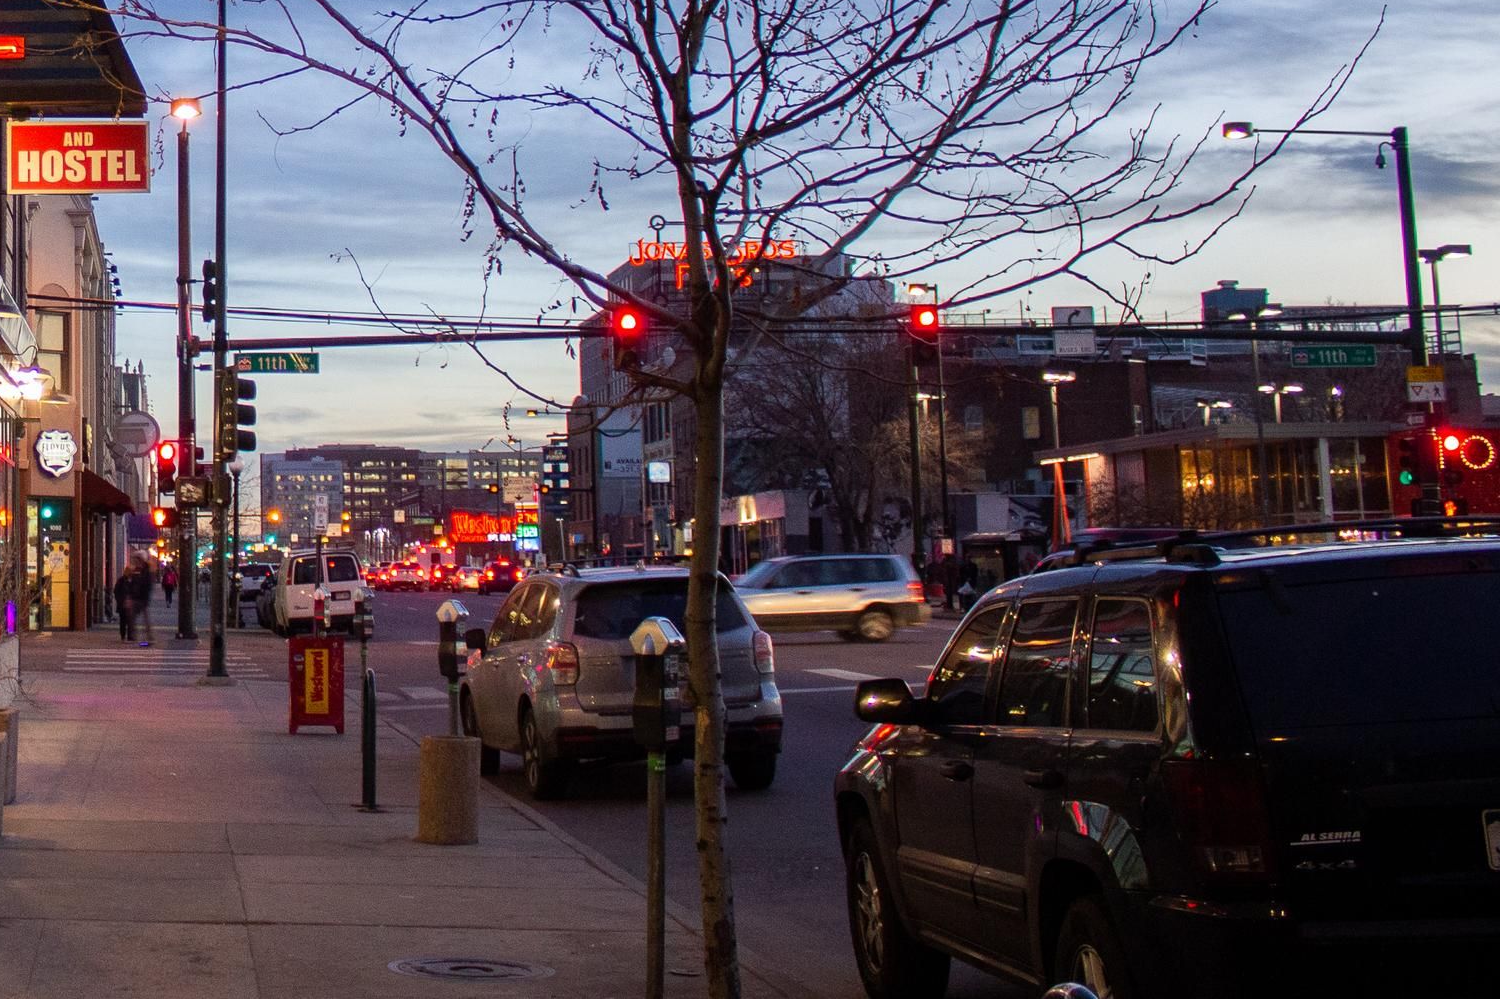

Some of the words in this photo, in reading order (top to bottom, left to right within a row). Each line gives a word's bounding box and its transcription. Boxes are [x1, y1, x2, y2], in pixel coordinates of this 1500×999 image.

[63, 132, 94, 147] AND
[17, 150, 142, 183] HOSTEL
[258, 356, 287, 370] 11th
[1319, 349, 1347, 363] 11th
[1300, 833, 1317, 841] AL
